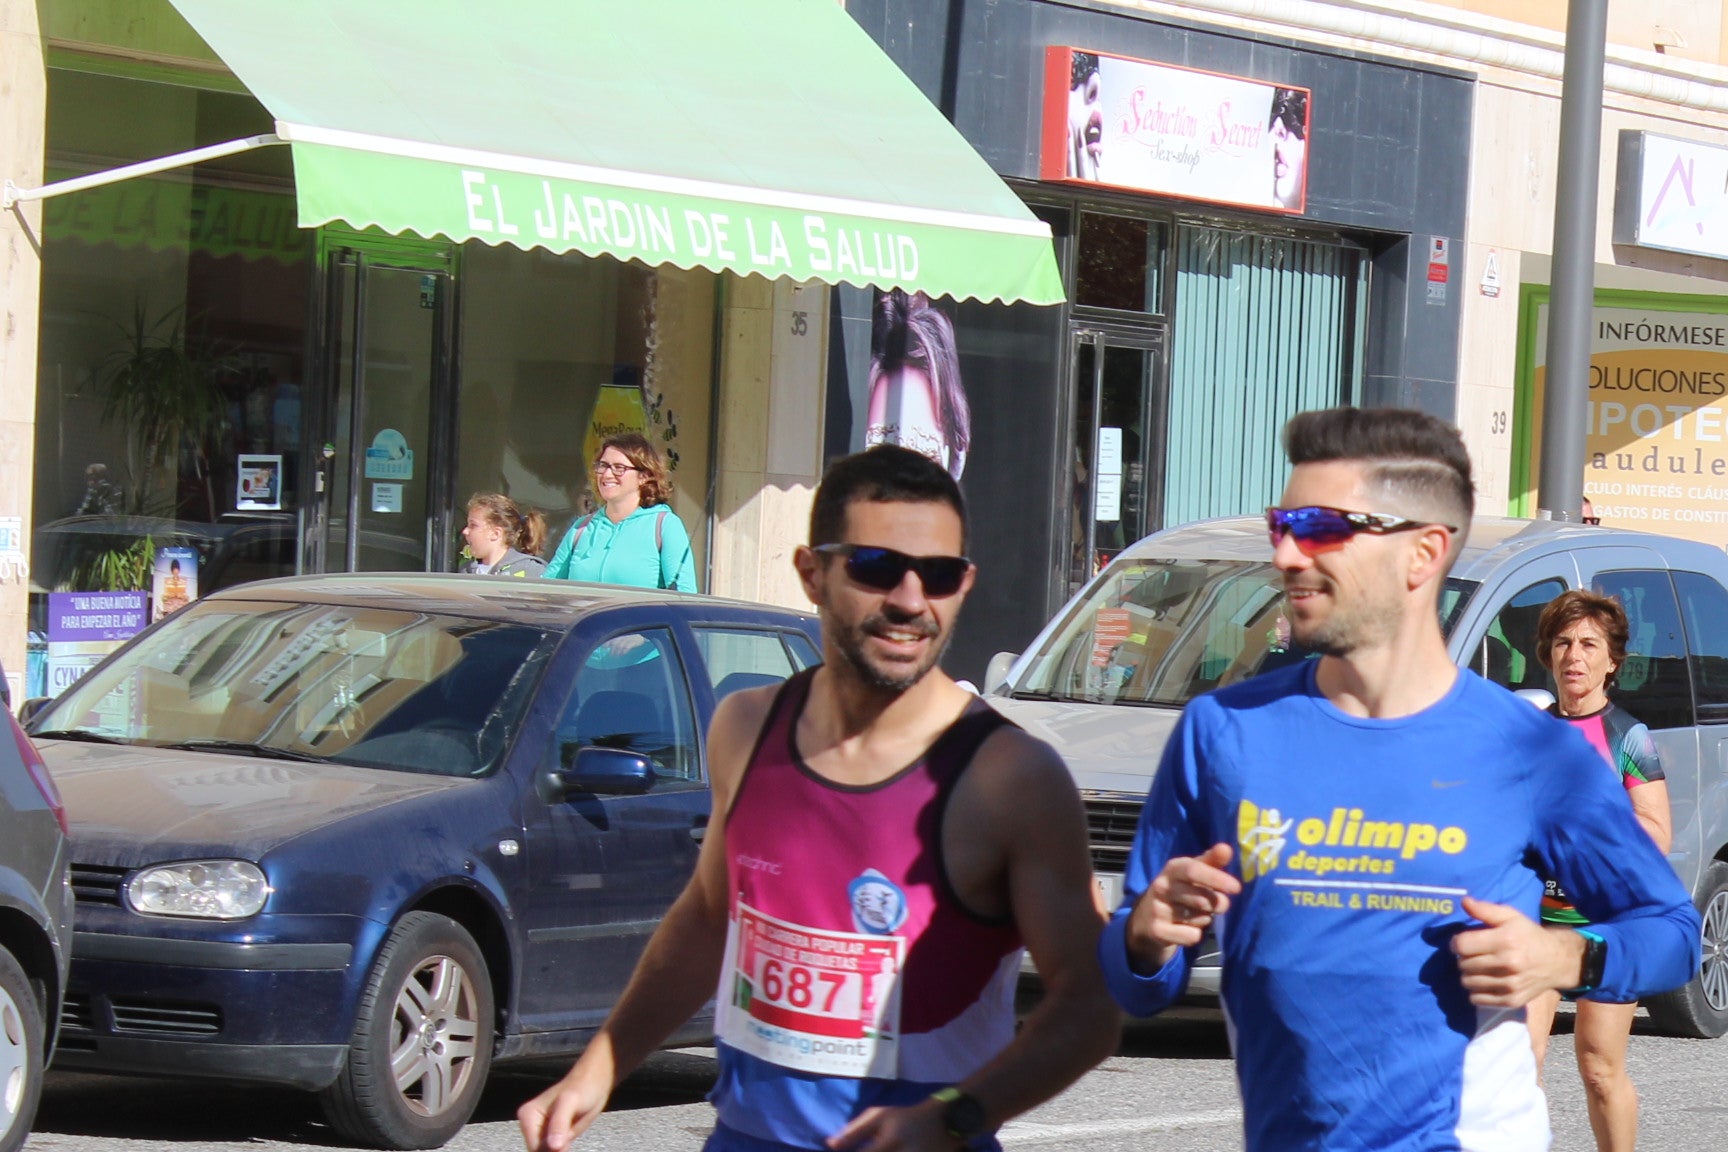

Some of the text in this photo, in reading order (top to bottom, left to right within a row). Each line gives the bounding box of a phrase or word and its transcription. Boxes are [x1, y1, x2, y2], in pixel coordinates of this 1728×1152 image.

[461, 170, 919, 281] EL JARDIN DE LA SALUD
[791, 311, 807, 337] 35
[1599, 318, 1725, 347] INFÓRMESE
[1588, 365, 1725, 396] OLUCIONES
[1491, 410, 1507, 435] 39
[1583, 481, 1622, 496] CULO
[1626, 482, 1682, 499] INTERÉS
[1593, 505, 1647, 520] GASTOS
[1652, 507, 1670, 521] DE
[1296, 807, 1468, 860] olimpo
[1287, 850, 1395, 876] deportes
[1291, 890, 1453, 915] TRAIL & RUNNING
[762, 959, 847, 1013] 687
